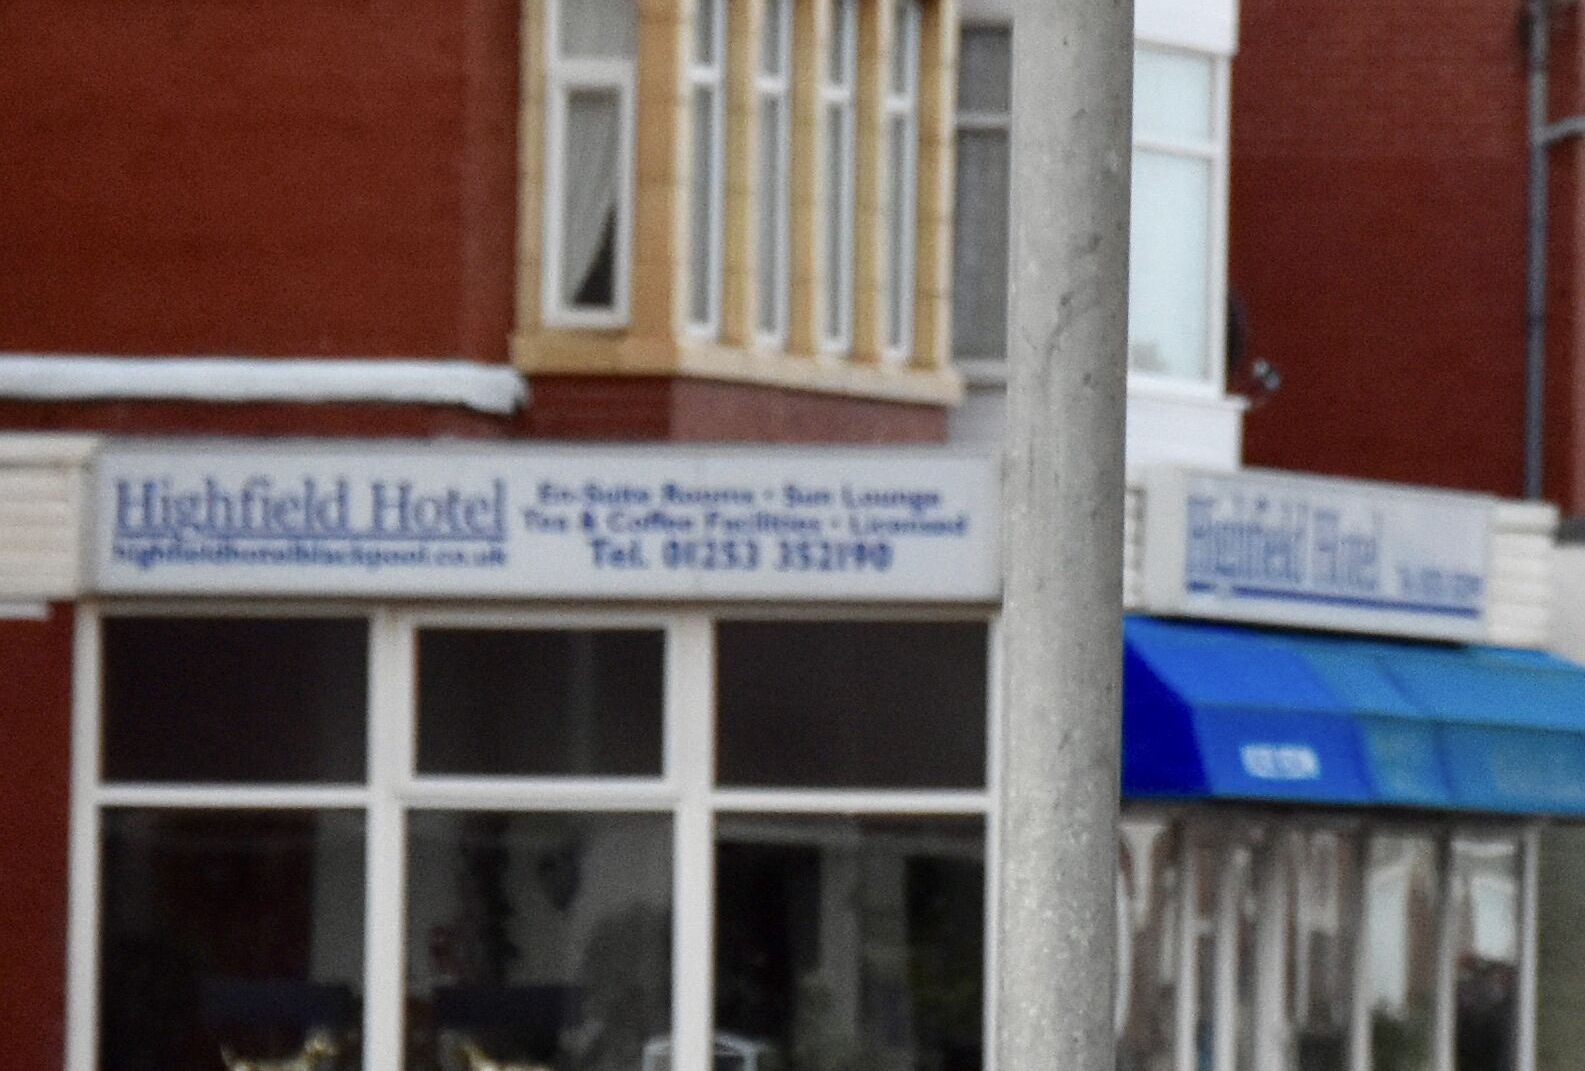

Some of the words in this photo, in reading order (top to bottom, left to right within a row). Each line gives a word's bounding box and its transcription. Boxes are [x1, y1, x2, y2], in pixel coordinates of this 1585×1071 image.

[115, 475, 349, 537] Highfield
[369, 476, 508, 532] Hotel
[783, 483, 831, 507] Sun
[842, 484, 942, 513] Lounge
[605, 509, 693, 533] Coffee
[704, 509, 823, 533] Facilities
[591, 538, 650, 569] Tel.
[662, 538, 760, 570] 01253
